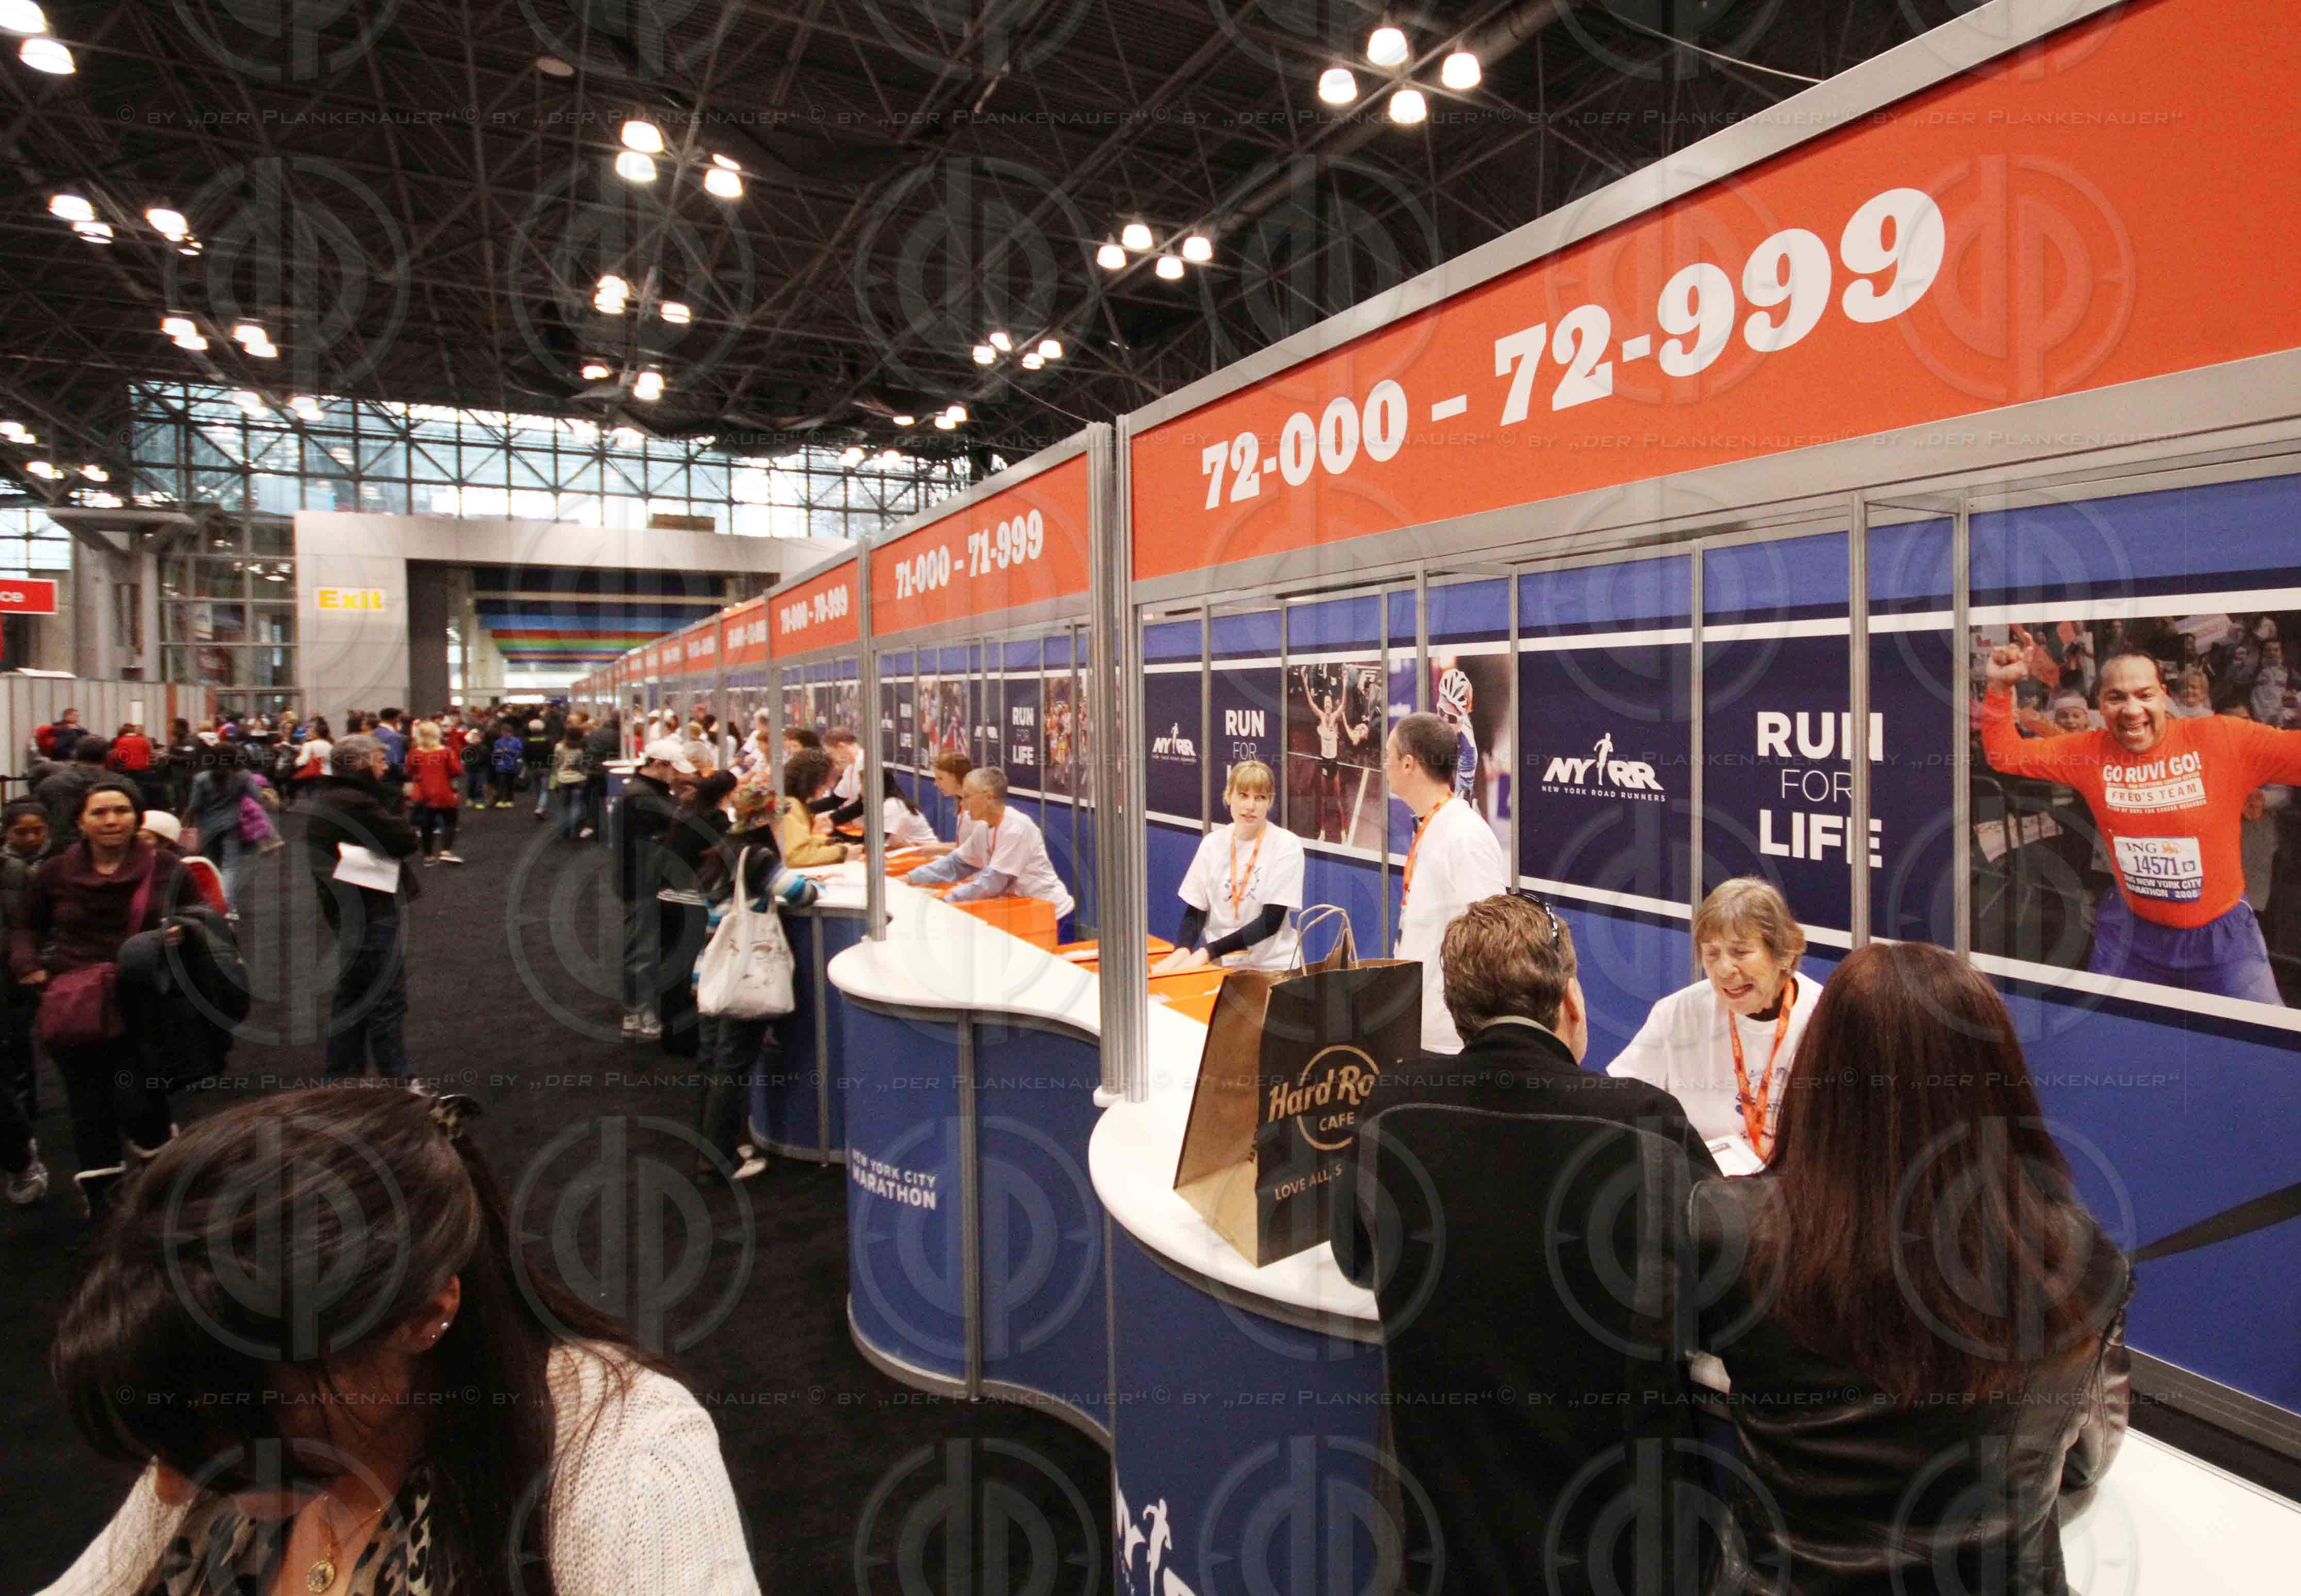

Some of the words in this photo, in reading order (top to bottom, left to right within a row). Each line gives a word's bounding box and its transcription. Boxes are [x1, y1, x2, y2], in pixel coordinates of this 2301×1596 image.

[1202, 379, 1408, 510] 72-000
[1495, 188, 1945, 426] 72-999
[896, 545, 951, 600] 71-000
[968, 509, 1043, 577] 71-999
[320, 589, 382, 608] Exit
[1225, 710, 1264, 737] RUN
[1233, 742, 1257, 760] FOR
[2103, 764, 2122, 782] GO
[2170, 751, 2202, 775] GO!
[1564, 787, 1586, 795] YORK
[1591, 789, 1615, 798] ROAD
[1621, 791, 1666, 802] RUNNERS
[2133, 856, 2180, 876] 14571
[1268, 1068, 1335, 1122] Hard
[1319, 1112, 1355, 1132] CAFE
[904, 1171, 936, 1188] CITY
[1275, 1177, 1306, 1200] LOVE
